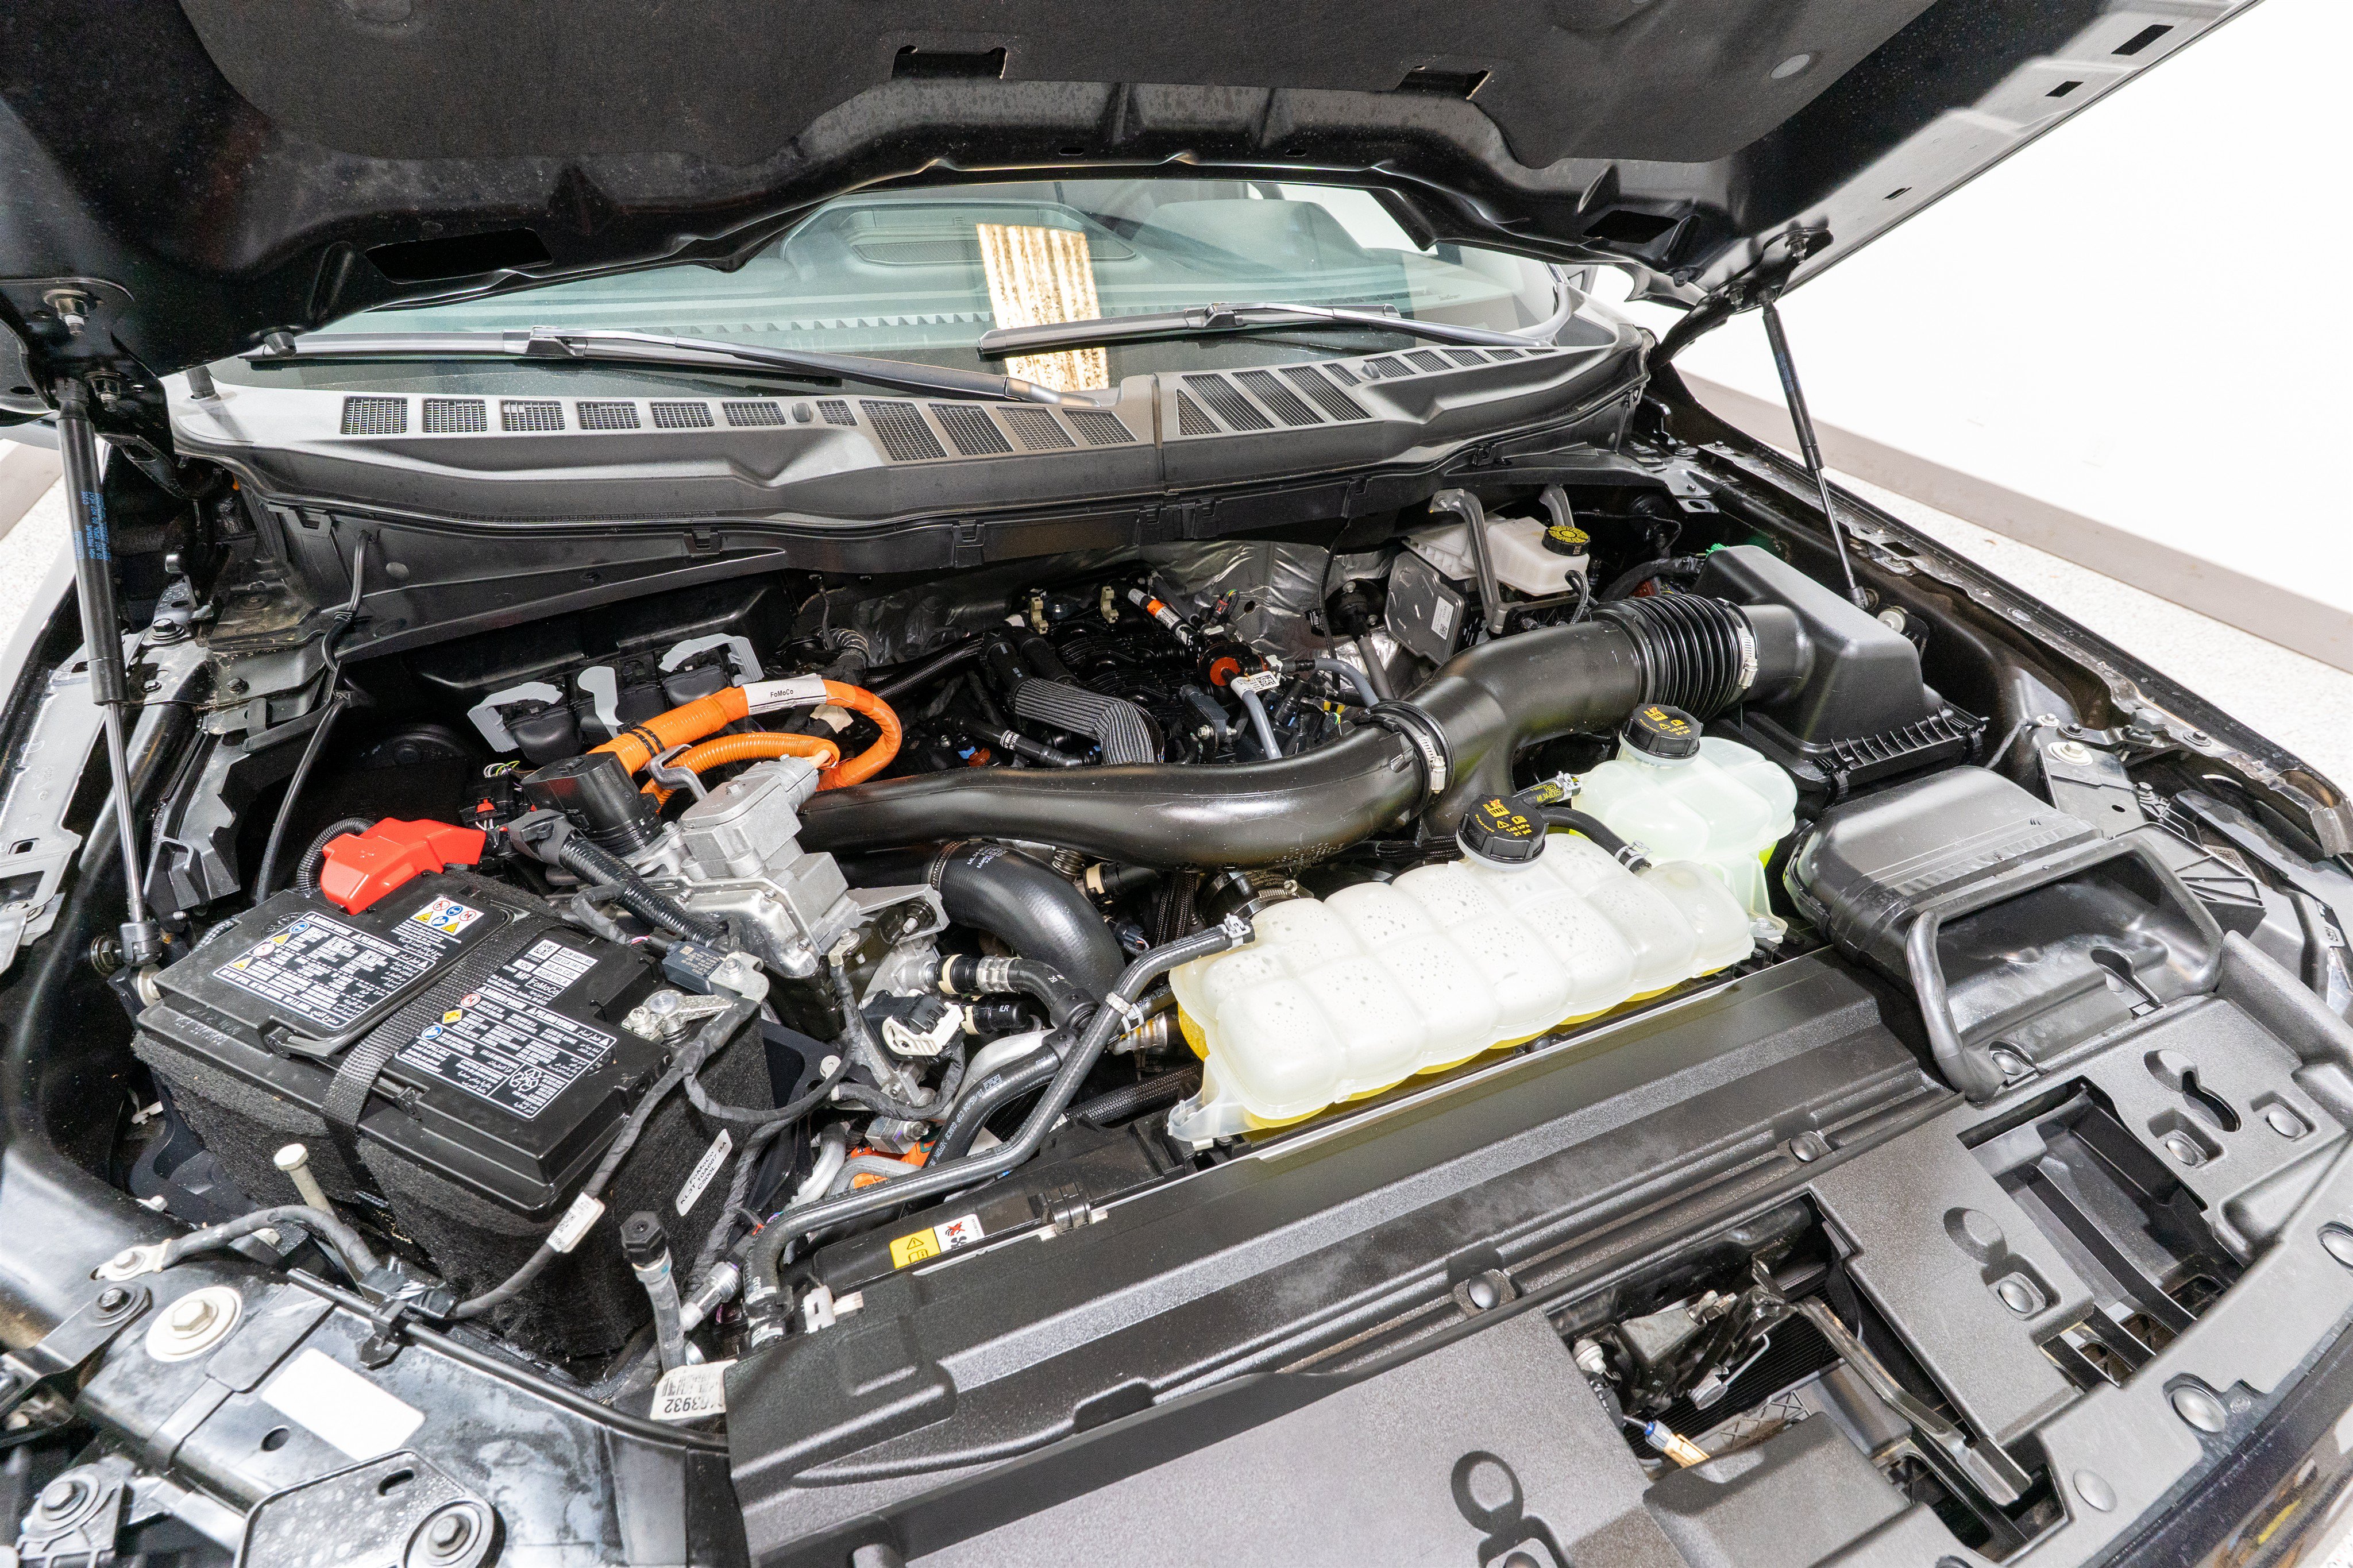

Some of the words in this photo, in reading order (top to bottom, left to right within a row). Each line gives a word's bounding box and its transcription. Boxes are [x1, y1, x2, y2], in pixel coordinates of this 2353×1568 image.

[770, 689, 794, 698] FoMoCo
[1544, 783, 1557, 792] HEV
[977, 855, 989, 868] Made
[512, 971, 533, 981] MF
[535, 970, 569, 984] AGM/VRLA
[1048, 975, 1058, 983] ISC
[527, 979, 561, 995] FoMoCo
[482, 988, 527, 1010] DANGER/POISON
[532, 1009, 579, 1032] PELIGRO/VENENO
[415, 1040, 451, 1057] NON-SPILLABLE
[459, 1059, 480, 1069] CONTRA
[965, 1087, 984, 1113] 10/05/24
[956, 1109, 965, 1124] CIP
[681, 1183, 695, 1204] KL3T
[697, 1154, 717, 1181] 10A687
[719, 1142, 726, 1153] BA
[689, 1152, 713, 1184] FoMoCo
[699, 1167, 716, 1190] C500L
[753, 1276, 762, 1291] RAD
